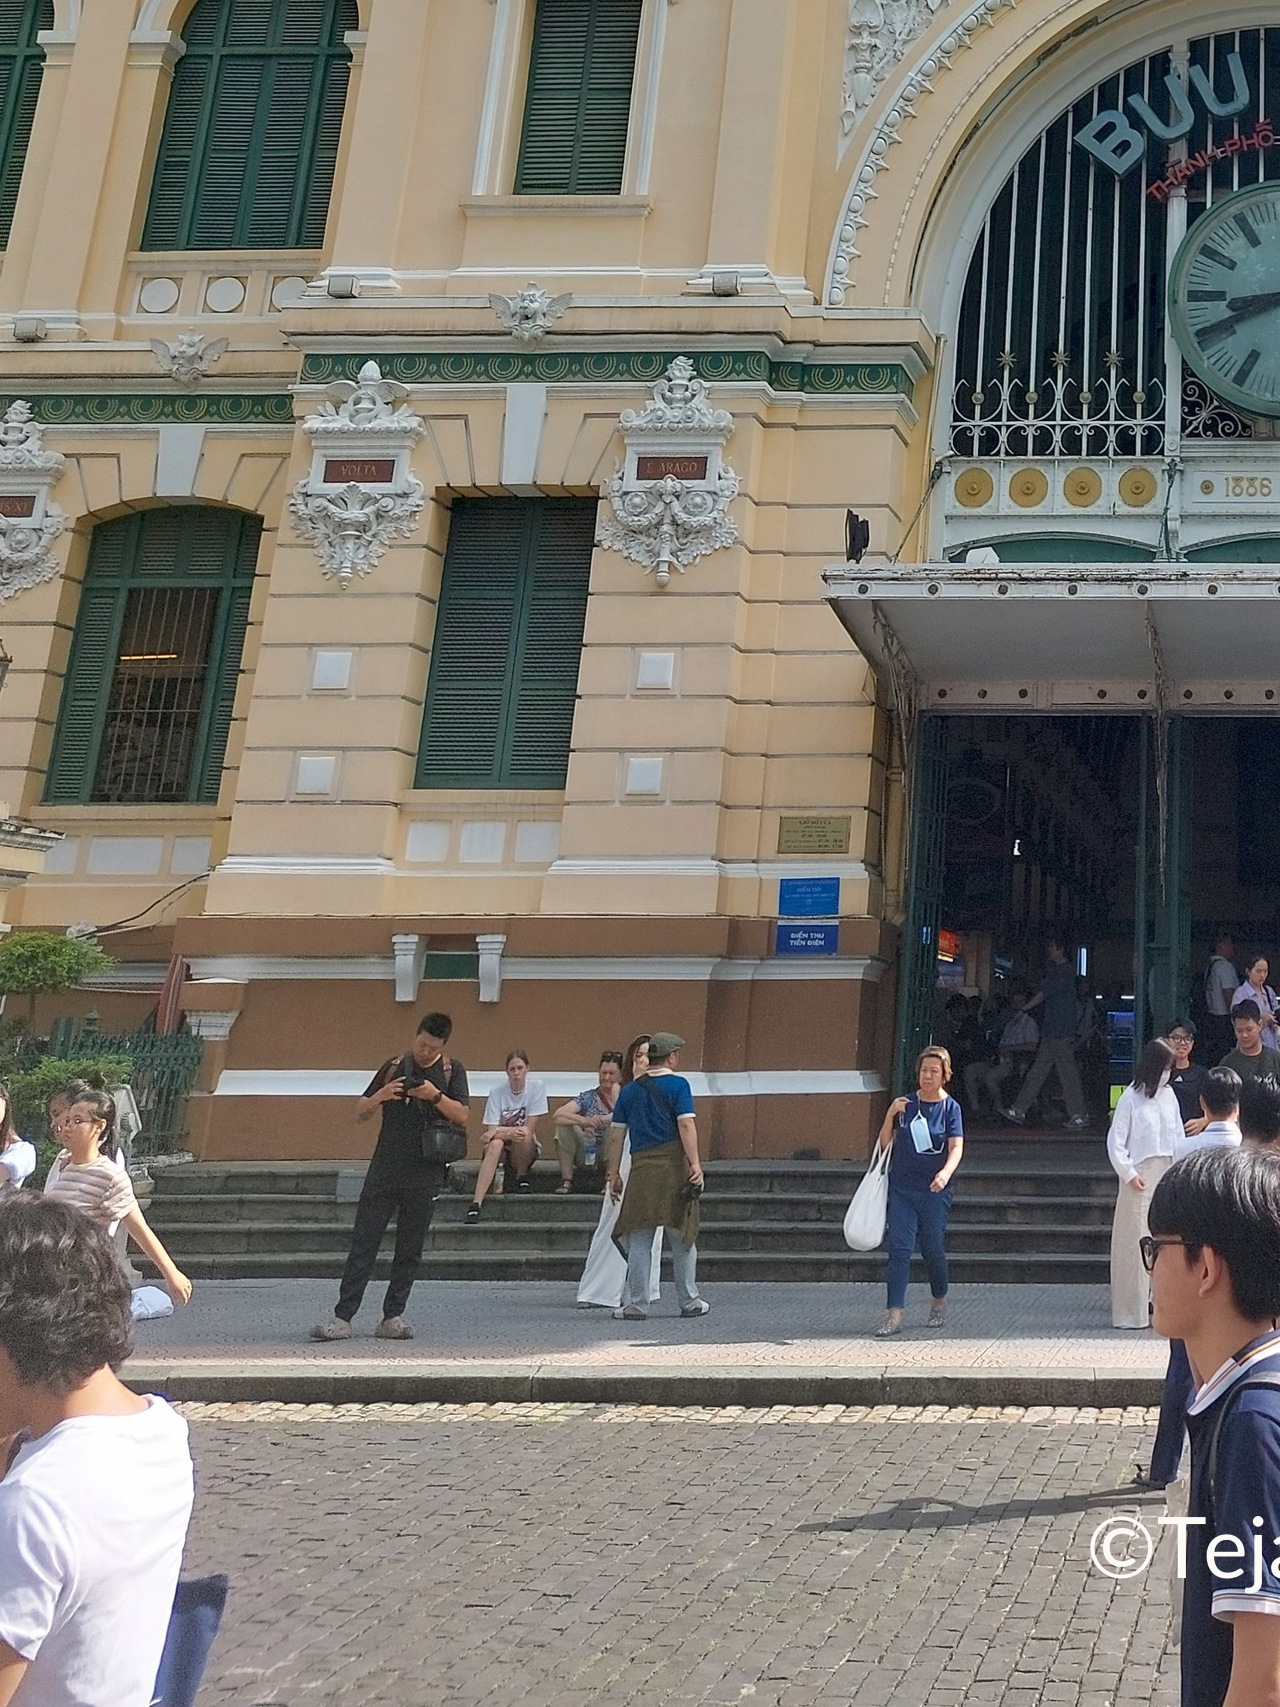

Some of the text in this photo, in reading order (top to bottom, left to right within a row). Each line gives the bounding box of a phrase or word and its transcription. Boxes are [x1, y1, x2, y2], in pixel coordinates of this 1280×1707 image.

[1073, 51, 1250, 177] BƯU
[1223, 118, 1274, 156] PHỐ
[341, 464, 377, 476] VOLTA
[659, 461, 698, 474] ARAGO
[1224, 476, 1273, 498] 1886
